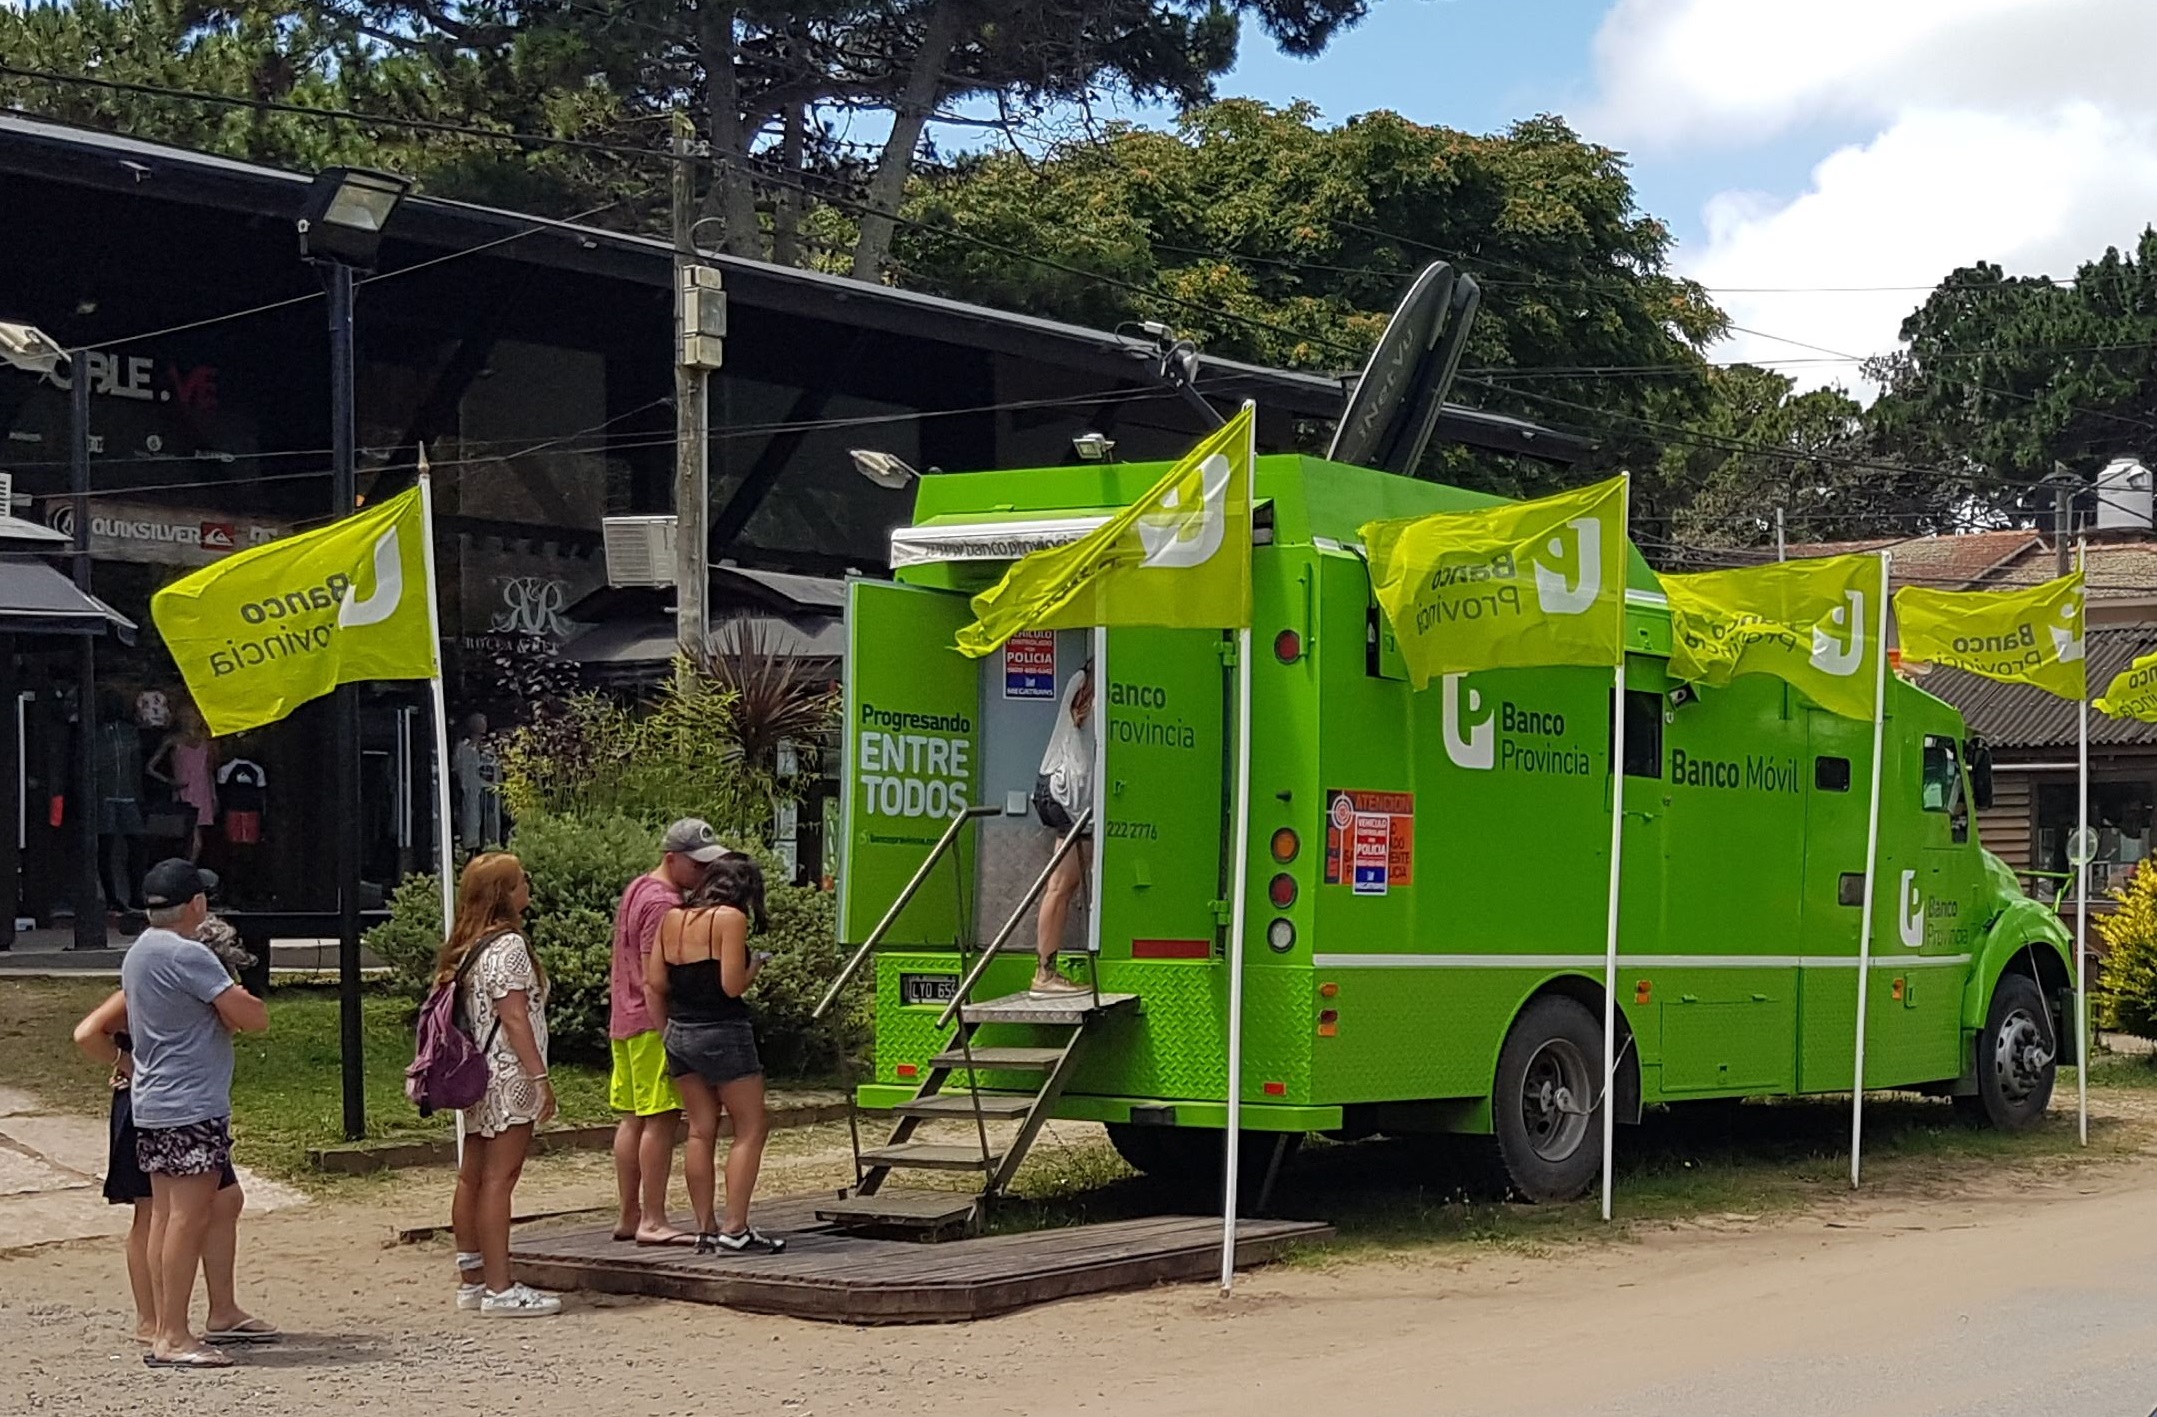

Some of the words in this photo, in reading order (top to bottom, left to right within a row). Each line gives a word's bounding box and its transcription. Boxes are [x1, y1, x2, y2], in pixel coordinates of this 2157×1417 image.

[91, 517, 203, 545] QUIKSILVER
[1006, 652, 1053, 663] POLICIA
[1107, 681, 1167, 709] anco
[861, 703, 971, 733] Progresando
[1110, 714, 1195, 749] rovincia
[1502, 701, 1565, 736] Banco
[861, 731, 970, 777] ENTRE
[1501, 738, 1590, 775] Provincia
[1672, 748, 1740, 789] Banco
[1746, 756, 1800, 793] Móvil
[860, 774, 968, 819] TODOS
[1356, 843, 1386, 855] POLICIA
